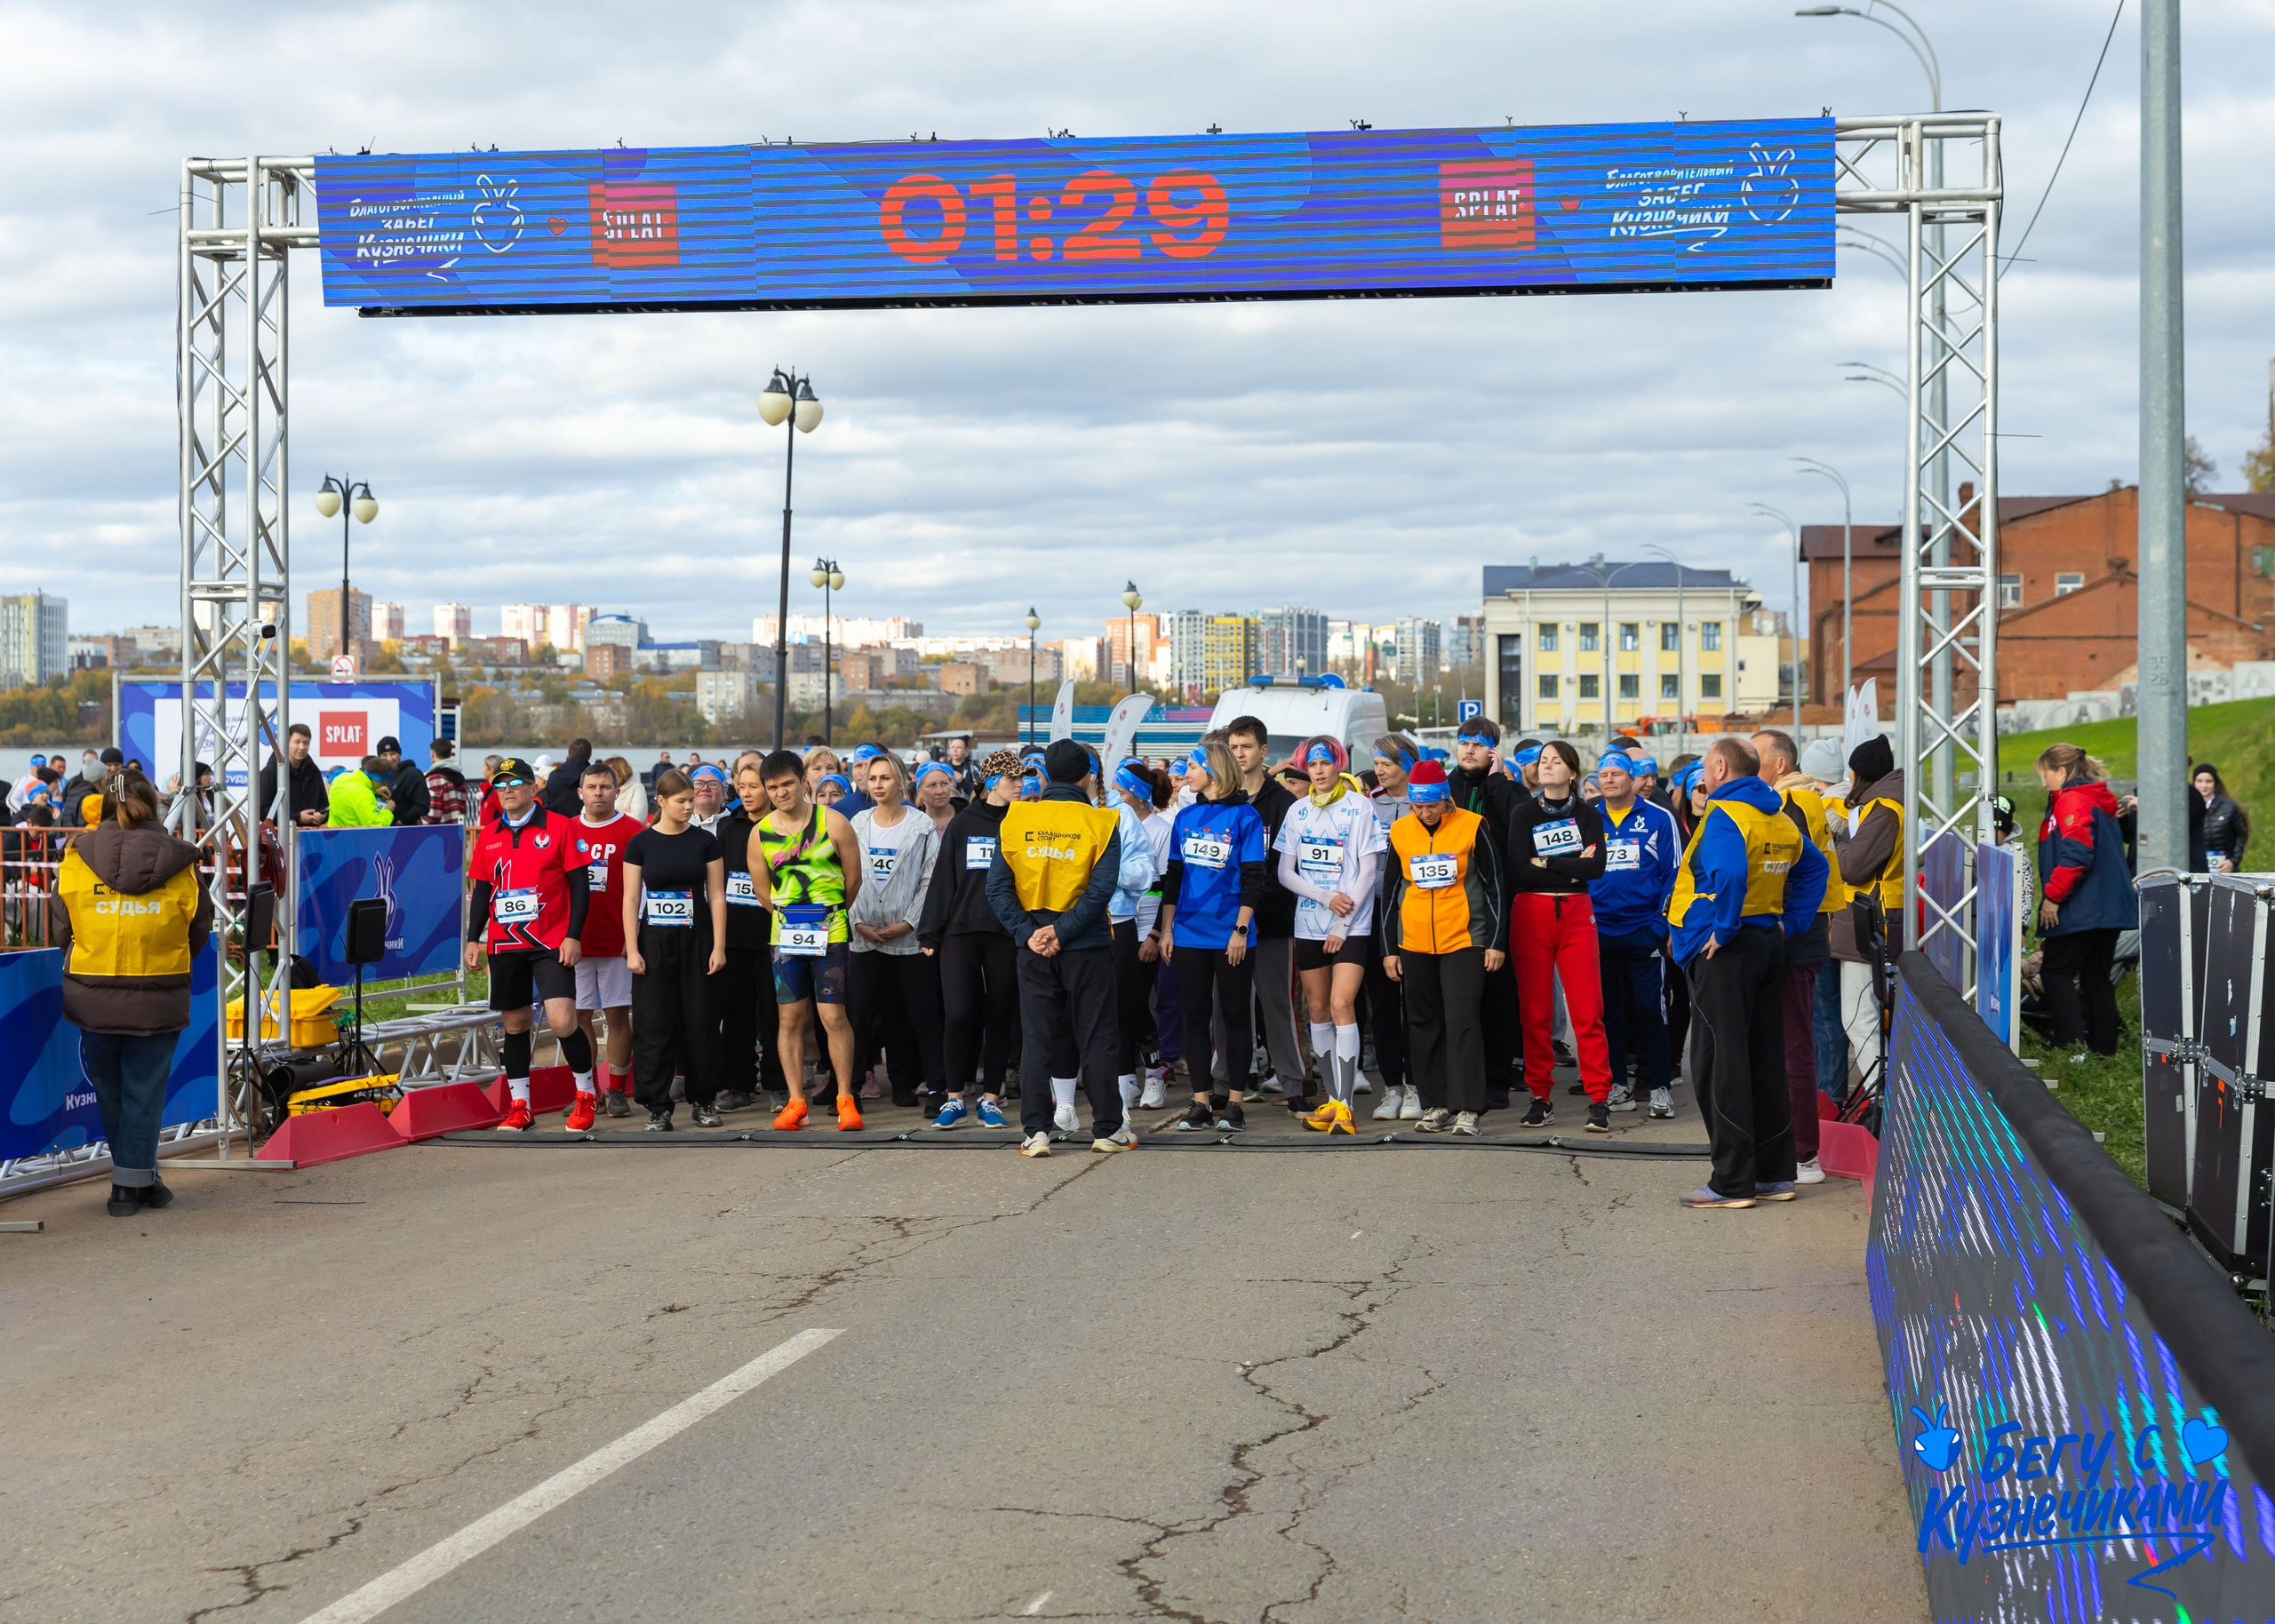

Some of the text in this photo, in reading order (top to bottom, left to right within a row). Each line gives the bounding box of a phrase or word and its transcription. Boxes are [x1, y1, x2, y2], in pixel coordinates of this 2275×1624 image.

[1454, 189, 1521, 221] SPLAT
[880, 169, 1229, 263] 01:29
[603, 210, 663, 239] SPLAT
[1465, 703, 1479, 720] P
[325, 725, 362, 743] SPLAT
[1037, 831, 1082, 840] КАЛАШНИКОВ
[1543, 830, 1574, 846] 148
[587, 843, 617, 860] СР
[1026, 846, 1075, 861] СУДЬЯ
[1193, 843, 1220, 857] 149
[1312, 848, 1329, 861] 91
[587, 870, 595, 881] 6
[1418, 864, 1449, 878] 135
[735, 883, 756, 895] 15
[96, 901, 161, 916] СУДЬЯ
[505, 900, 526, 912] 86
[655, 903, 685, 914] 102
[793, 934, 816, 945] 94
